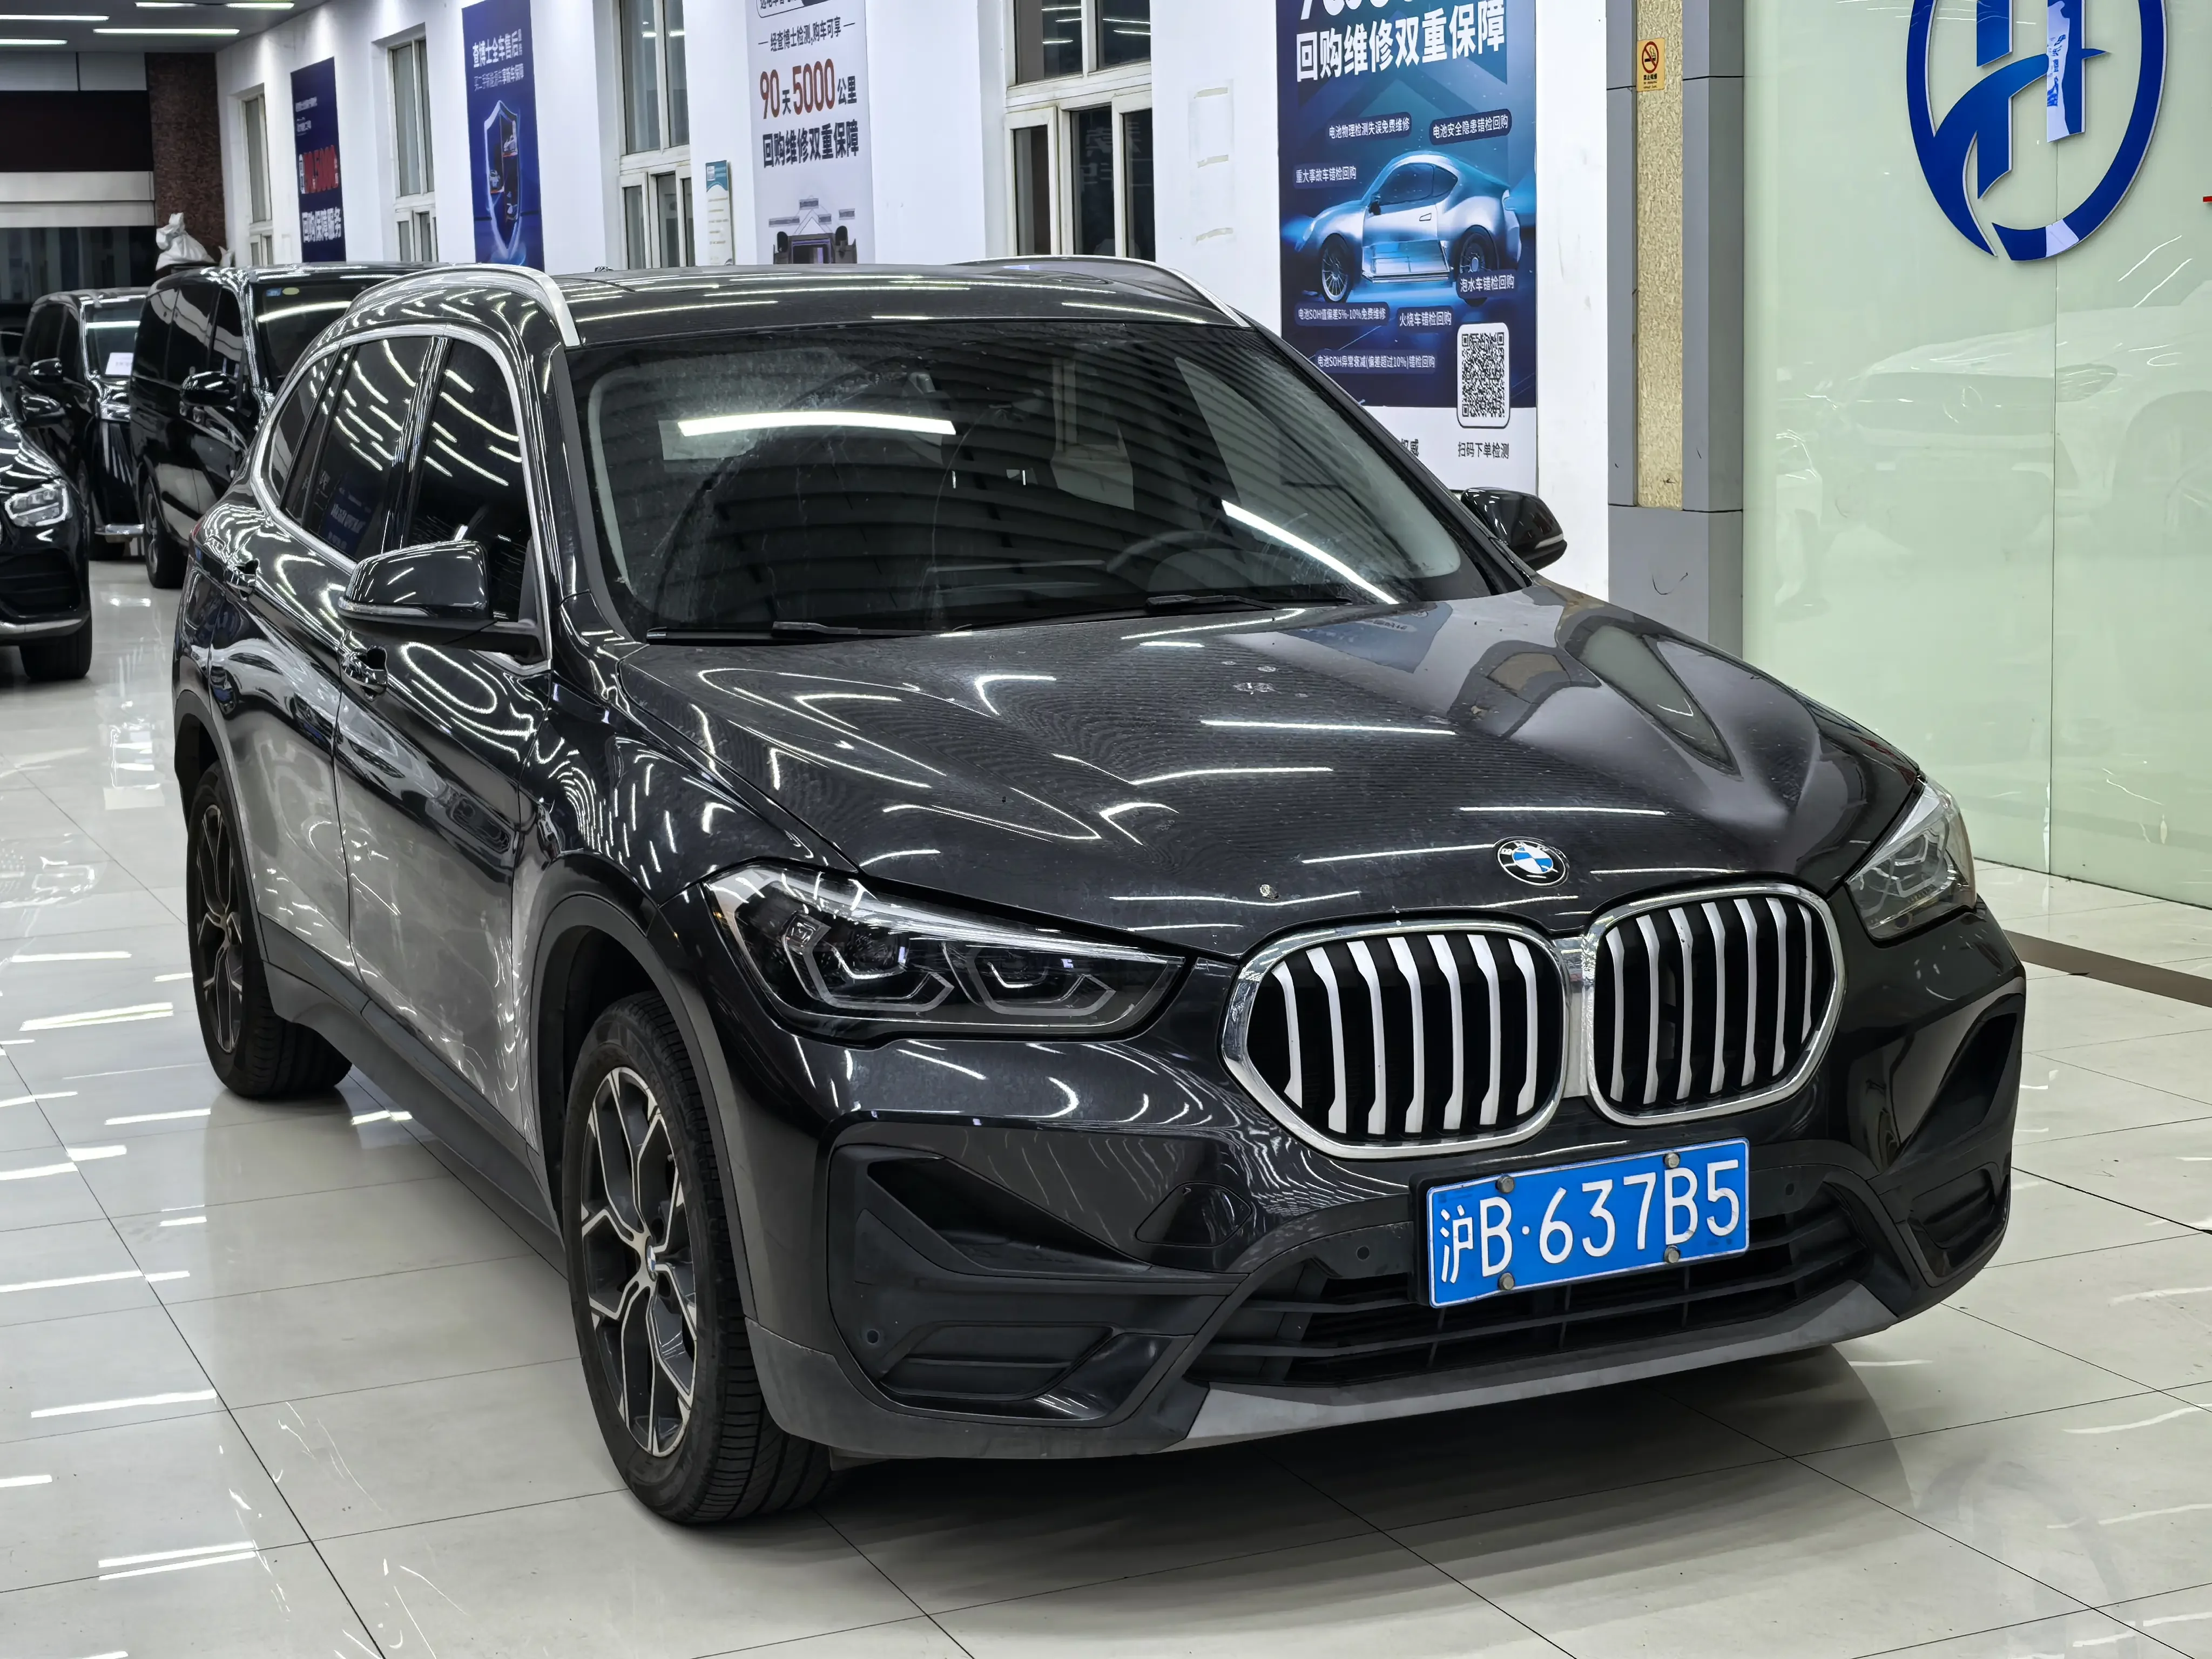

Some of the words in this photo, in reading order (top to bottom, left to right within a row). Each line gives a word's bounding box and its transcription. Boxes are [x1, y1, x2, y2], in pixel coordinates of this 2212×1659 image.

[1297, 1, 1505, 82] 回购维修双重保障
[1329, 117, 1410, 139] 电池物理检测失误免费维修
[1433, 114, 1508, 138] 电池安全隐患错检回购
[763, 119, 859, 168] 回购维修双重保障
[1296, 166, 1357, 183] 重大事故车错检回购
[1460, 274, 1514, 292] 泡水车错检回购
[1399, 311, 1452, 327] 火烧车错检回购
[1458, 441, 1510, 459] 扫码下单检测
[1440, 1159, 1739, 1284] 沪B·637B5
